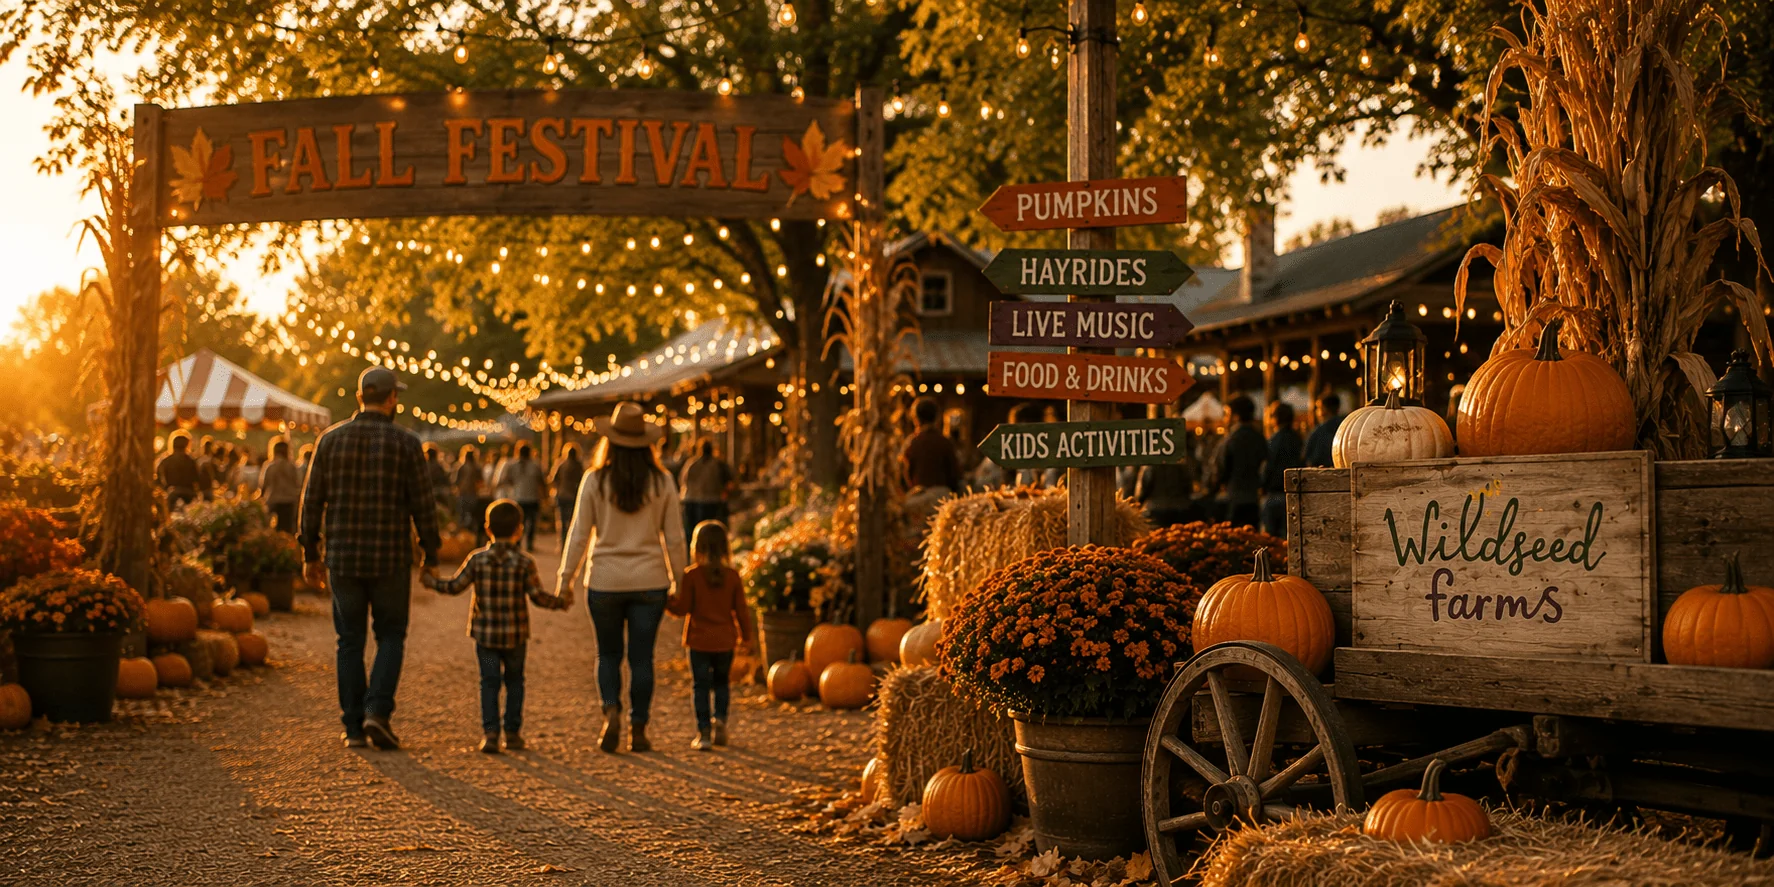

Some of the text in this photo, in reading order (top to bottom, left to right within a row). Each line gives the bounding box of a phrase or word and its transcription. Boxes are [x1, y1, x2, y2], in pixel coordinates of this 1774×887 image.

[248, 117, 771, 198] FALL FESTIVAL
[1016, 186, 1158, 222] PUMPKINS
[1020, 257, 1147, 286] HAYRIDES
[1011, 310, 1155, 340] LIVE MUSIC
[1002, 361, 1168, 395] FOOD & DRINKS
[1000, 428, 1175, 460] KIDS ACTIVITIES
[1383, 492, 1607, 576] Wildseed
[1425, 567, 1563, 624] farms
